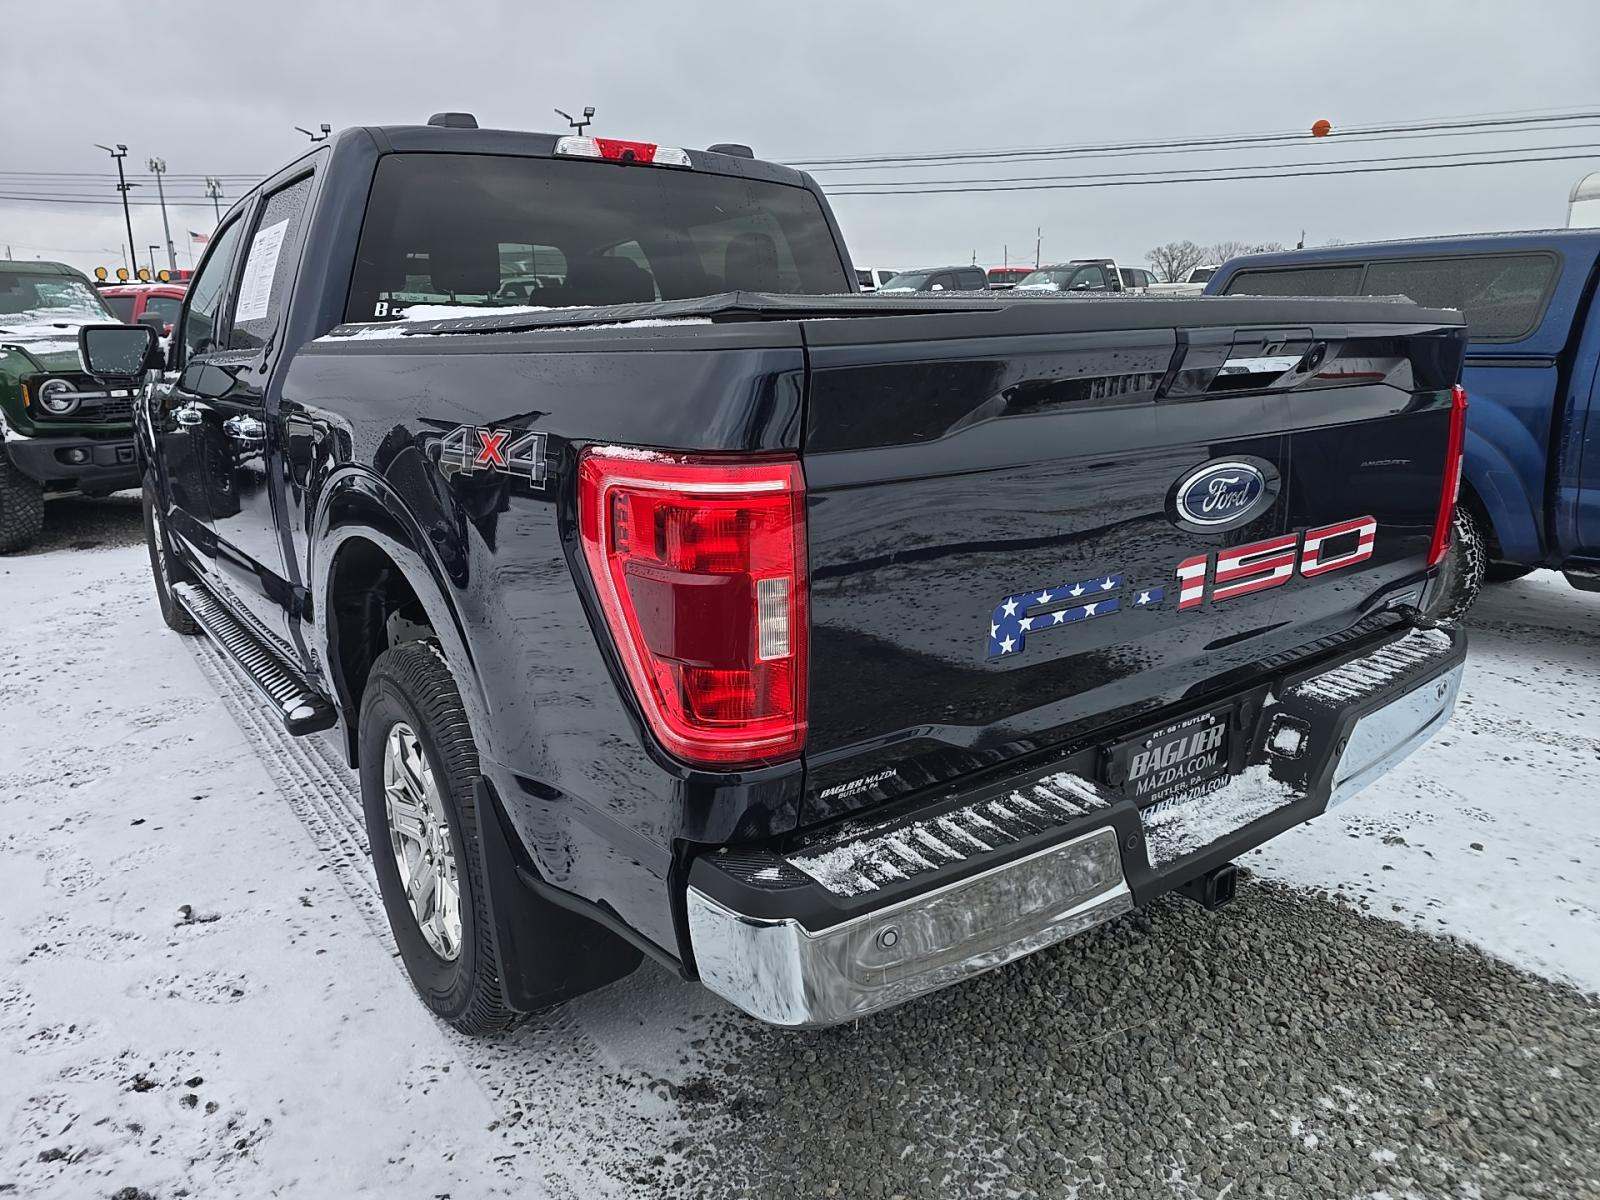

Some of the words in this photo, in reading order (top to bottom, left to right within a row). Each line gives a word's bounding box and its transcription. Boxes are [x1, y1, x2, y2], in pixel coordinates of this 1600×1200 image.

[1202, 476, 1251, 512] Ford
[986, 514, 1378, 661] F-150
[1153, 729, 1165, 739] RT.
[1182, 713, 1211, 728] BUTLER
[1128, 723, 1226, 781] BAGLIER
[864, 768, 897, 785] MAZDA
[1136, 751, 1218, 796] MAZDA.COM
[838, 785, 867, 800] BUTLER
